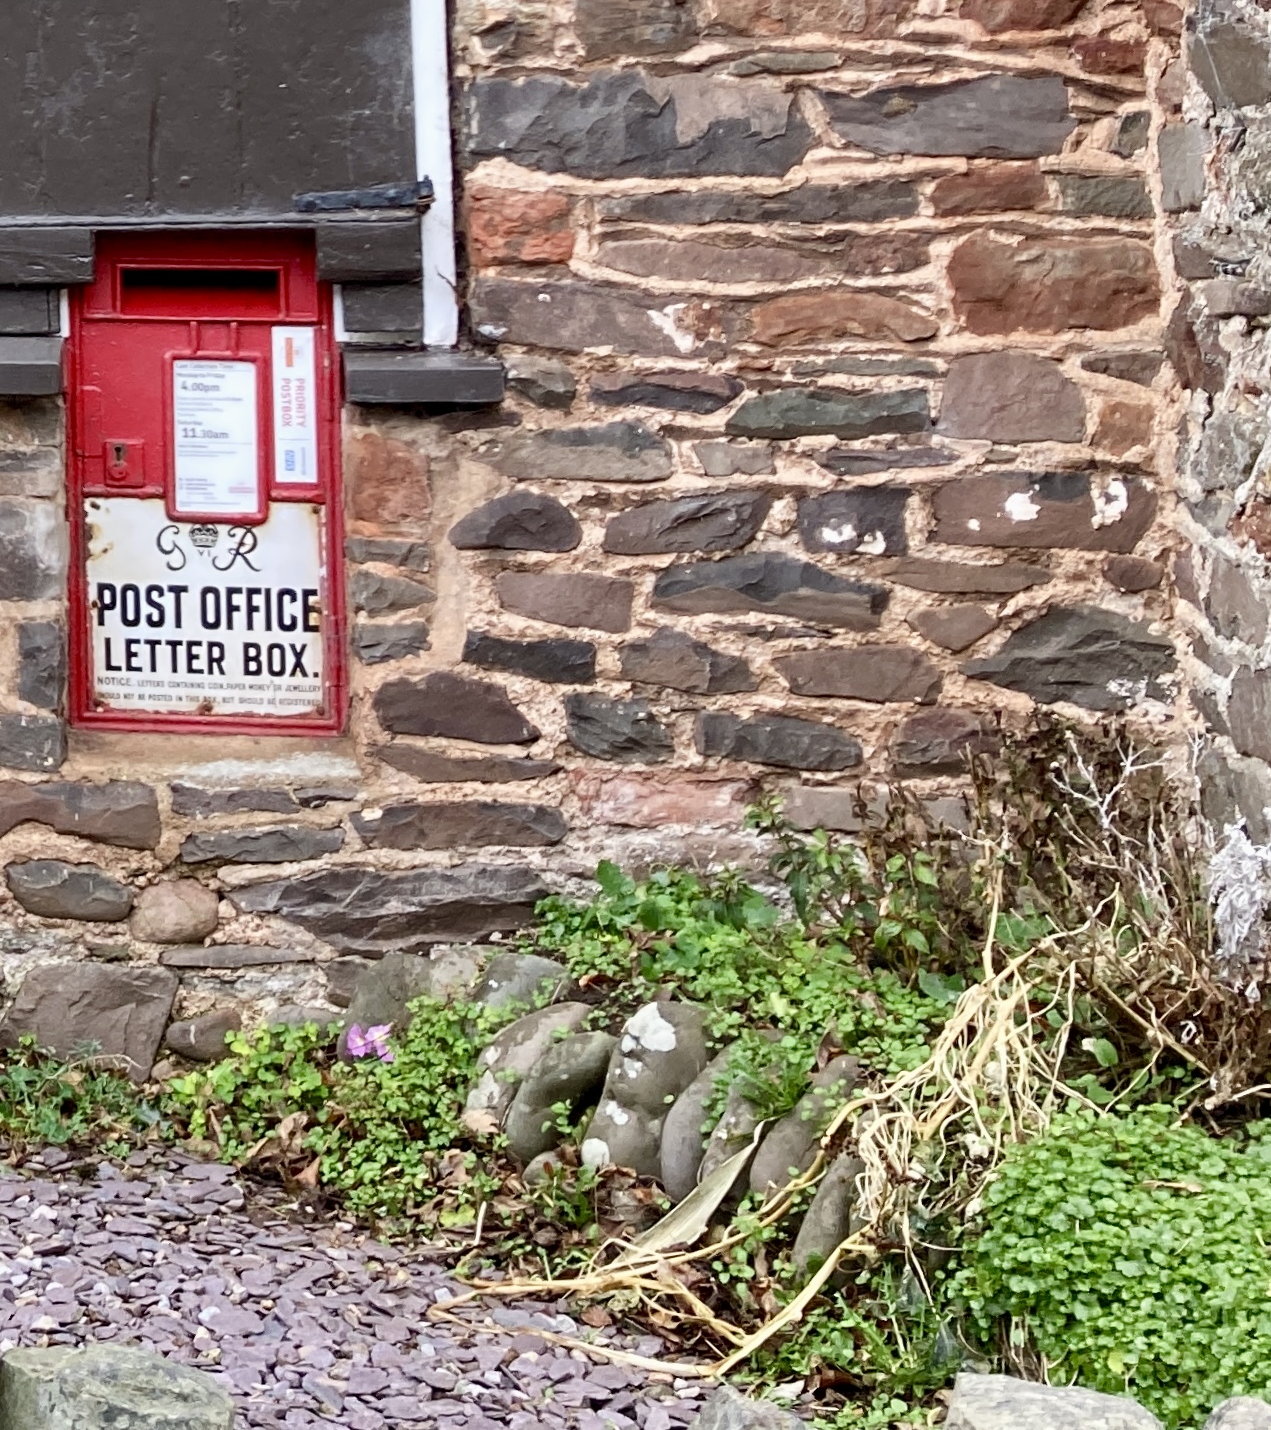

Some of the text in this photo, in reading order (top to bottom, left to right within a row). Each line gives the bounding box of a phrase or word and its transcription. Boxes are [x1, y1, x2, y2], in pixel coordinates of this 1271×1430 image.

[181, 380, 220, 393] 4.00pm
[281, 377, 293, 428] POSTBOX
[295, 377, 306, 428] PRIORITY
[156, 524, 263, 572] G R
[96, 582, 321, 633] POST OFFICE
[104, 637, 320, 678] LETTER BOX.
[148, 694, 173, 702] POSTED
